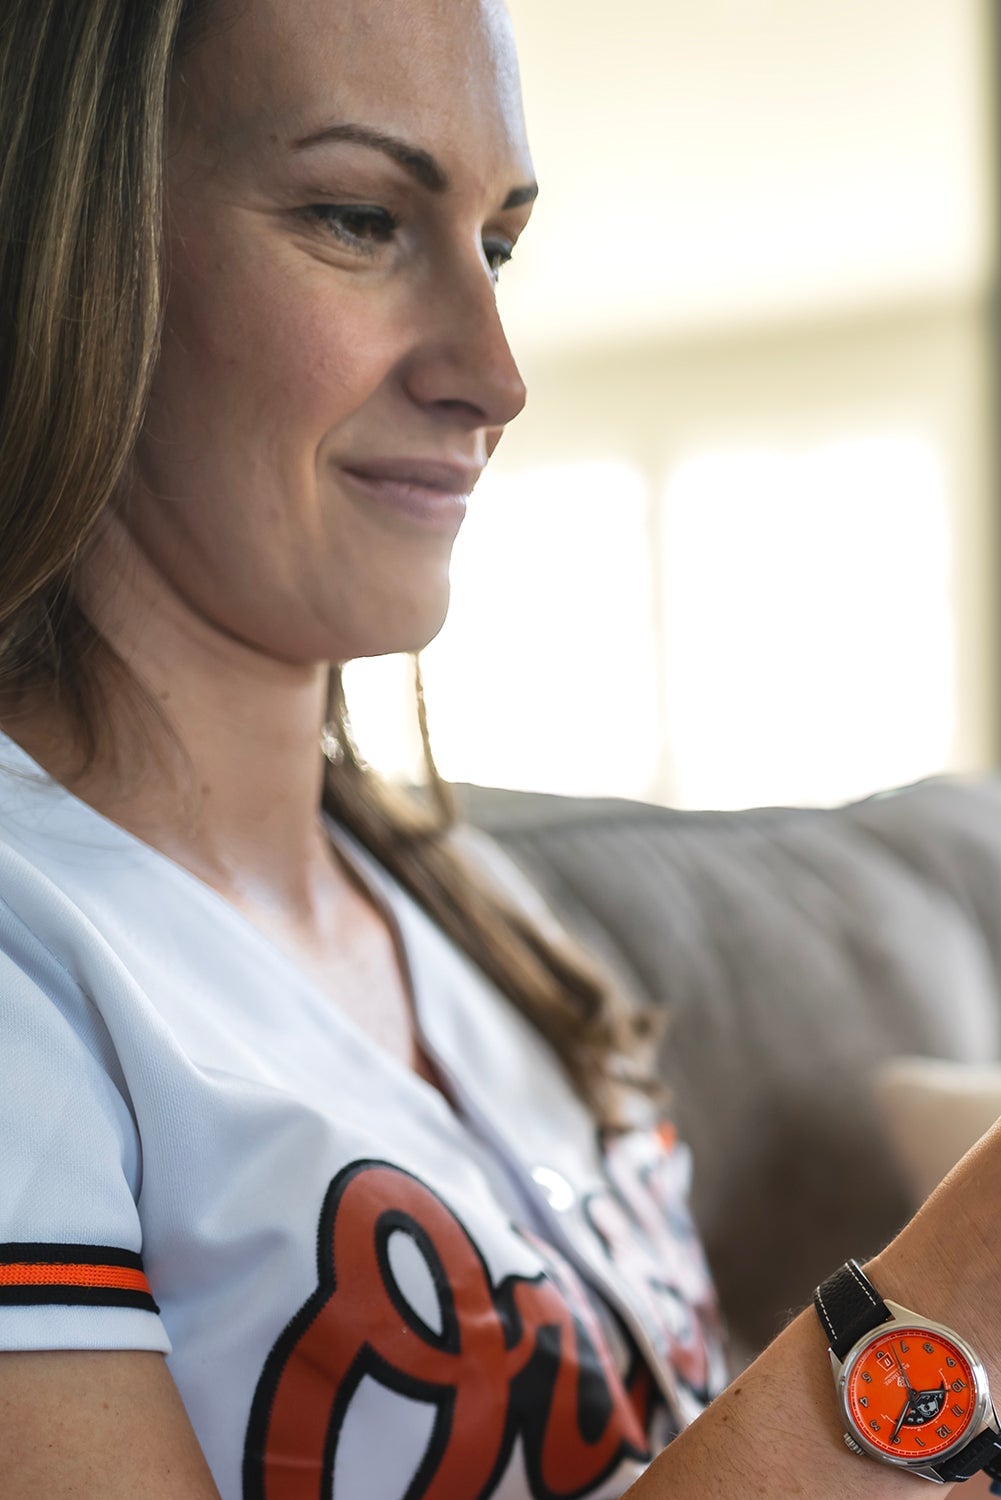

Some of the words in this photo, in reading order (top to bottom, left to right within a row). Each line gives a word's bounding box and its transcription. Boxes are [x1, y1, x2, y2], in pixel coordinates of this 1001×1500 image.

[900, 1341, 909, 1353] 7
[923, 1342, 934, 1354] 8
[946, 1357, 956, 1368] 9
[861, 1371, 872, 1383] 5
[951, 1379, 966, 1392] 10
[859, 1396, 868, 1408] 4
[951, 1405, 964, 1417] 11
[869, 1420, 881, 1431] 3
[936, 1425, 952, 1438] 12
[915, 1437, 925, 1447] 1
